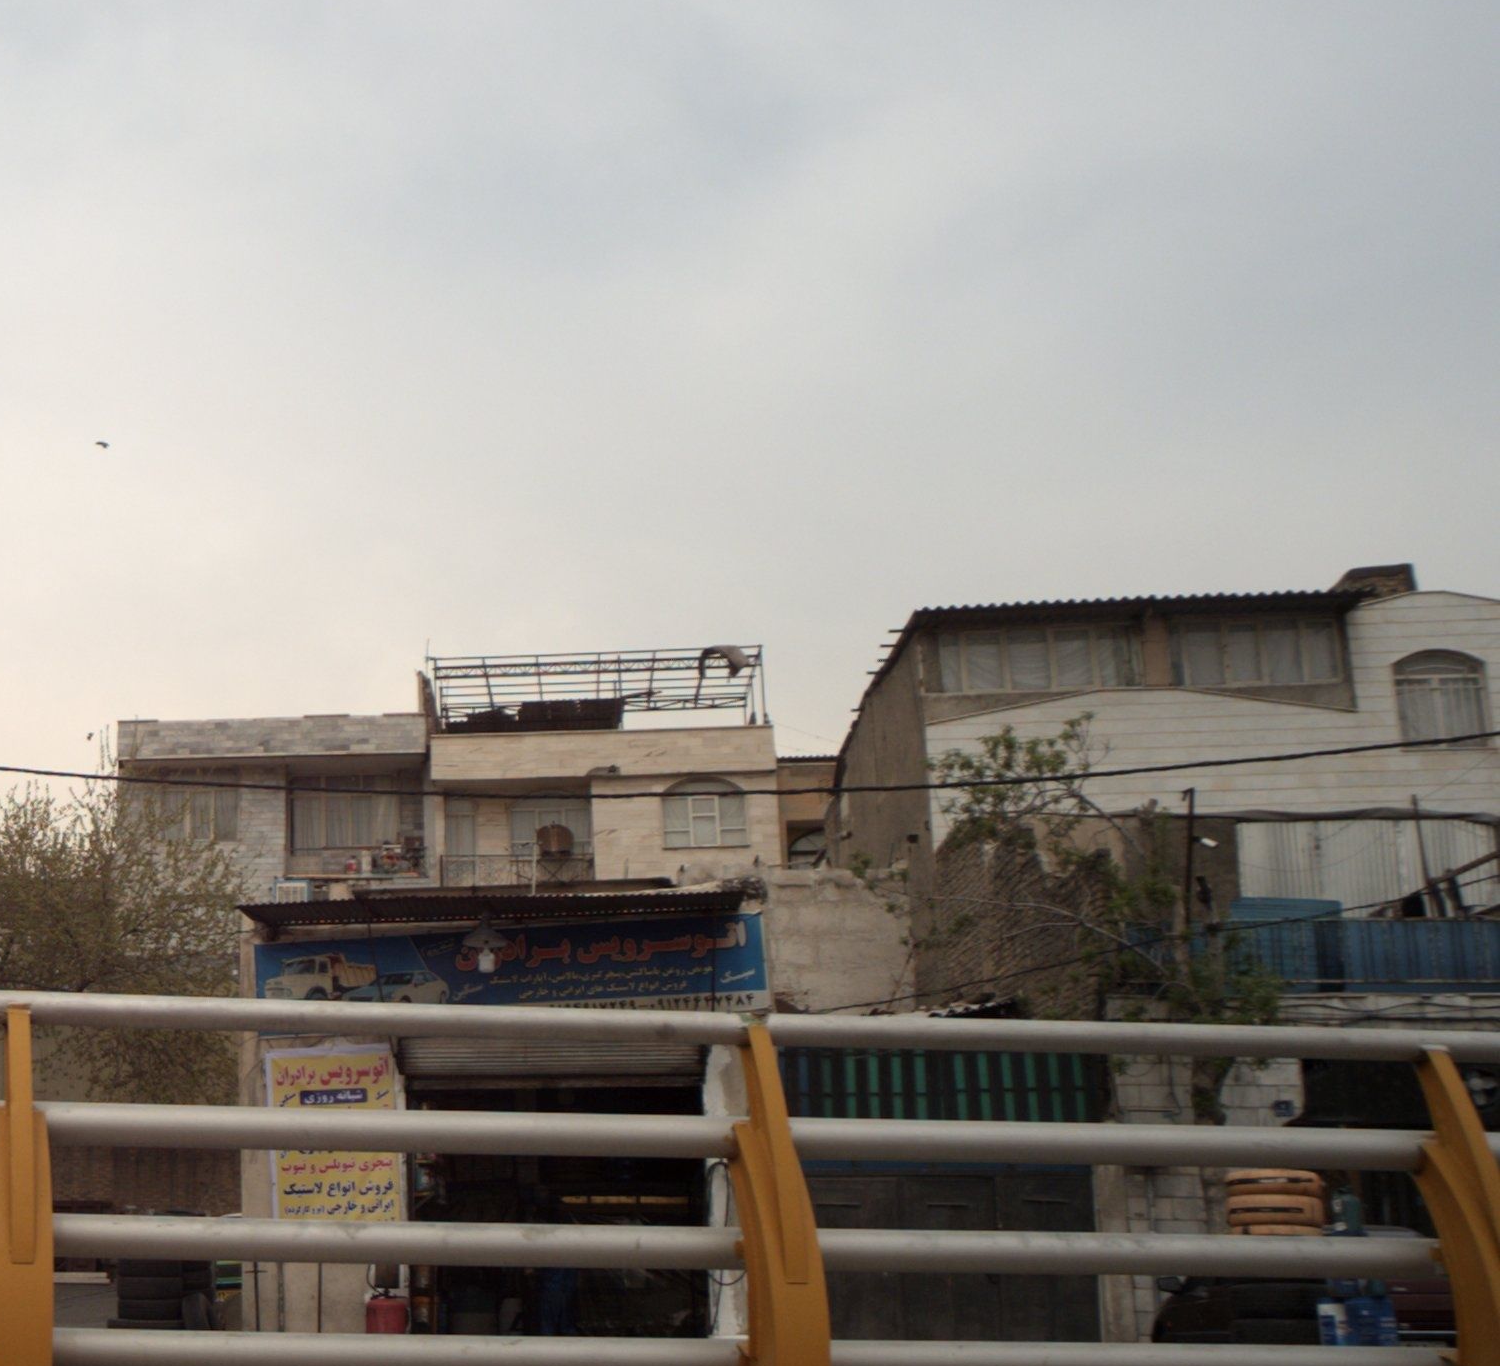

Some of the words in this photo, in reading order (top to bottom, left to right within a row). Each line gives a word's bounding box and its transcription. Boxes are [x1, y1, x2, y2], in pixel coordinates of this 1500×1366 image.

[276, 1065, 316, 1086] برادران
[284, 1181, 323, 1197] لاستیک
[327, 1180, 356, 1197] انواع
[359, 1179, 394, 1195] فروش
[327, 1199, 357, 1215] خارجی
[367, 1198, 395, 1213] ایرانی
